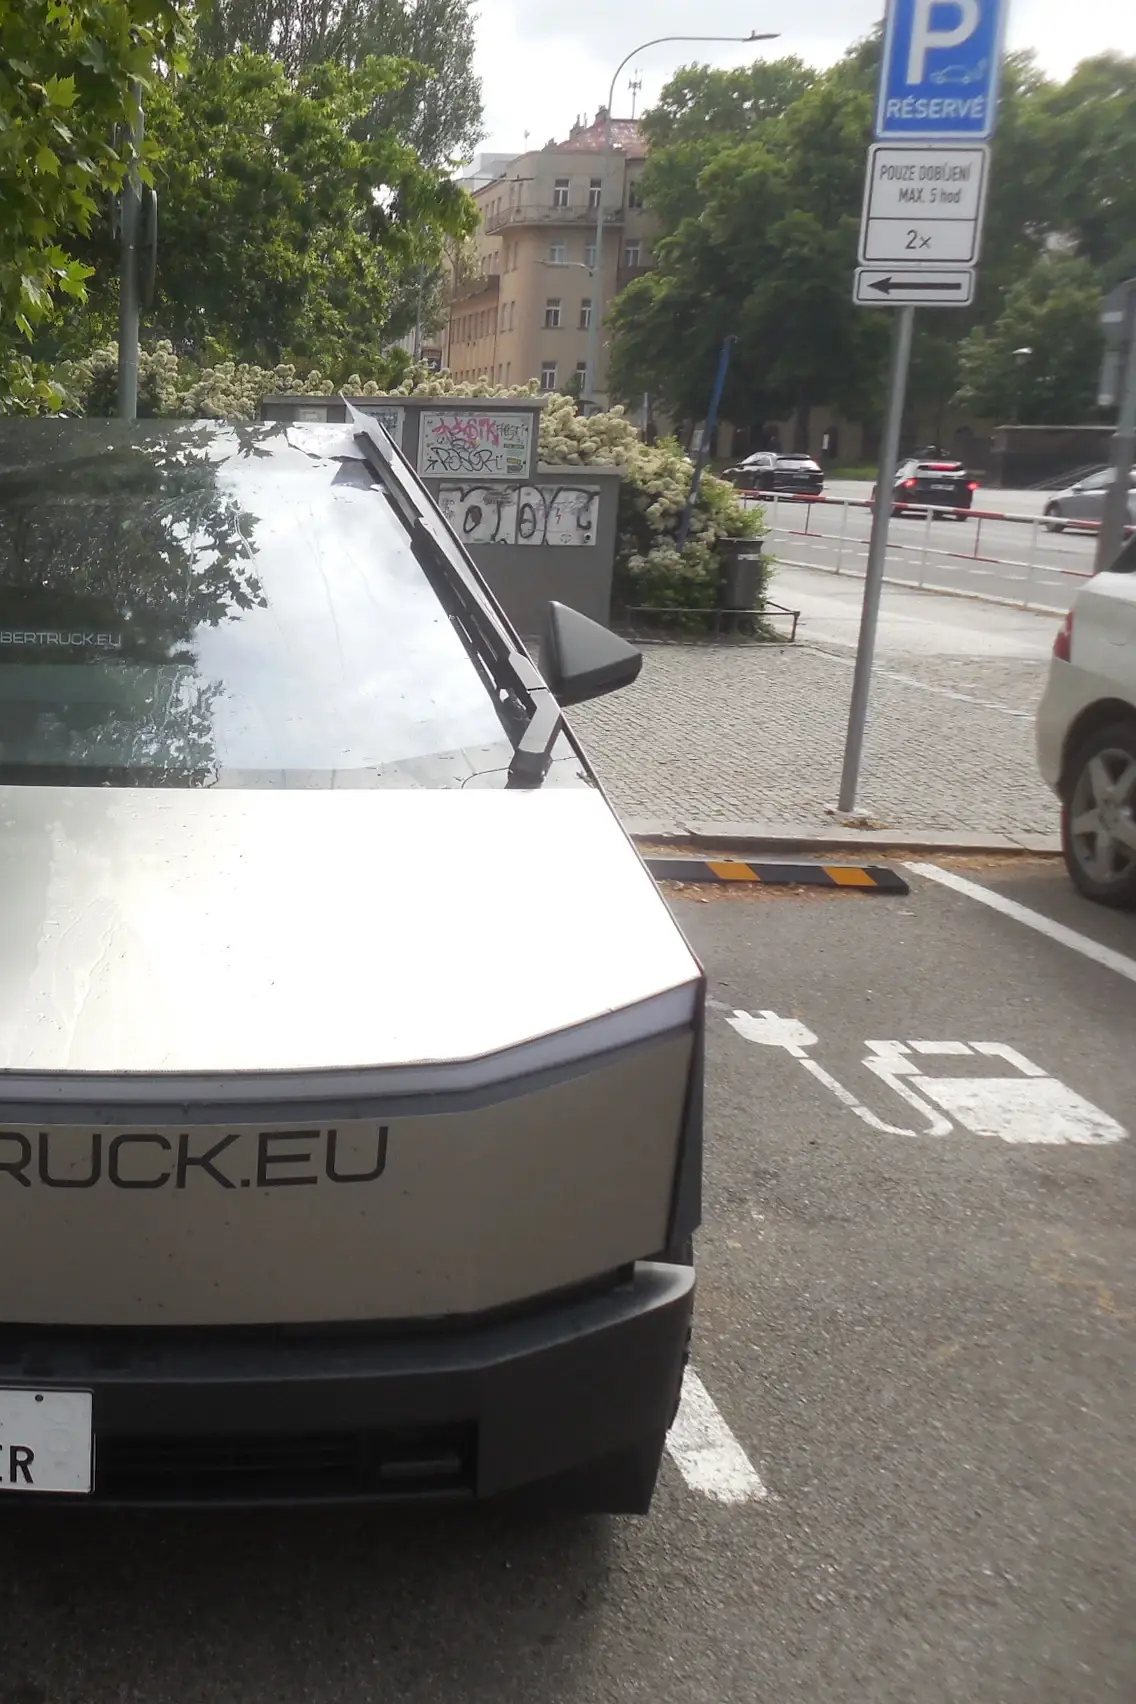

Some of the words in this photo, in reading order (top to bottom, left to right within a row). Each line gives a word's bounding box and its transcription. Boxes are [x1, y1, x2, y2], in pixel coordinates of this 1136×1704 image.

[905, 0, 981, 85] P
[886, 96, 985, 119] RÉSERVÉ
[880, 165, 916, 182] POUZE
[899, 187, 924, 203] MAX.
[930, 187, 937, 203] 5
[940, 187, 962, 203] hod
